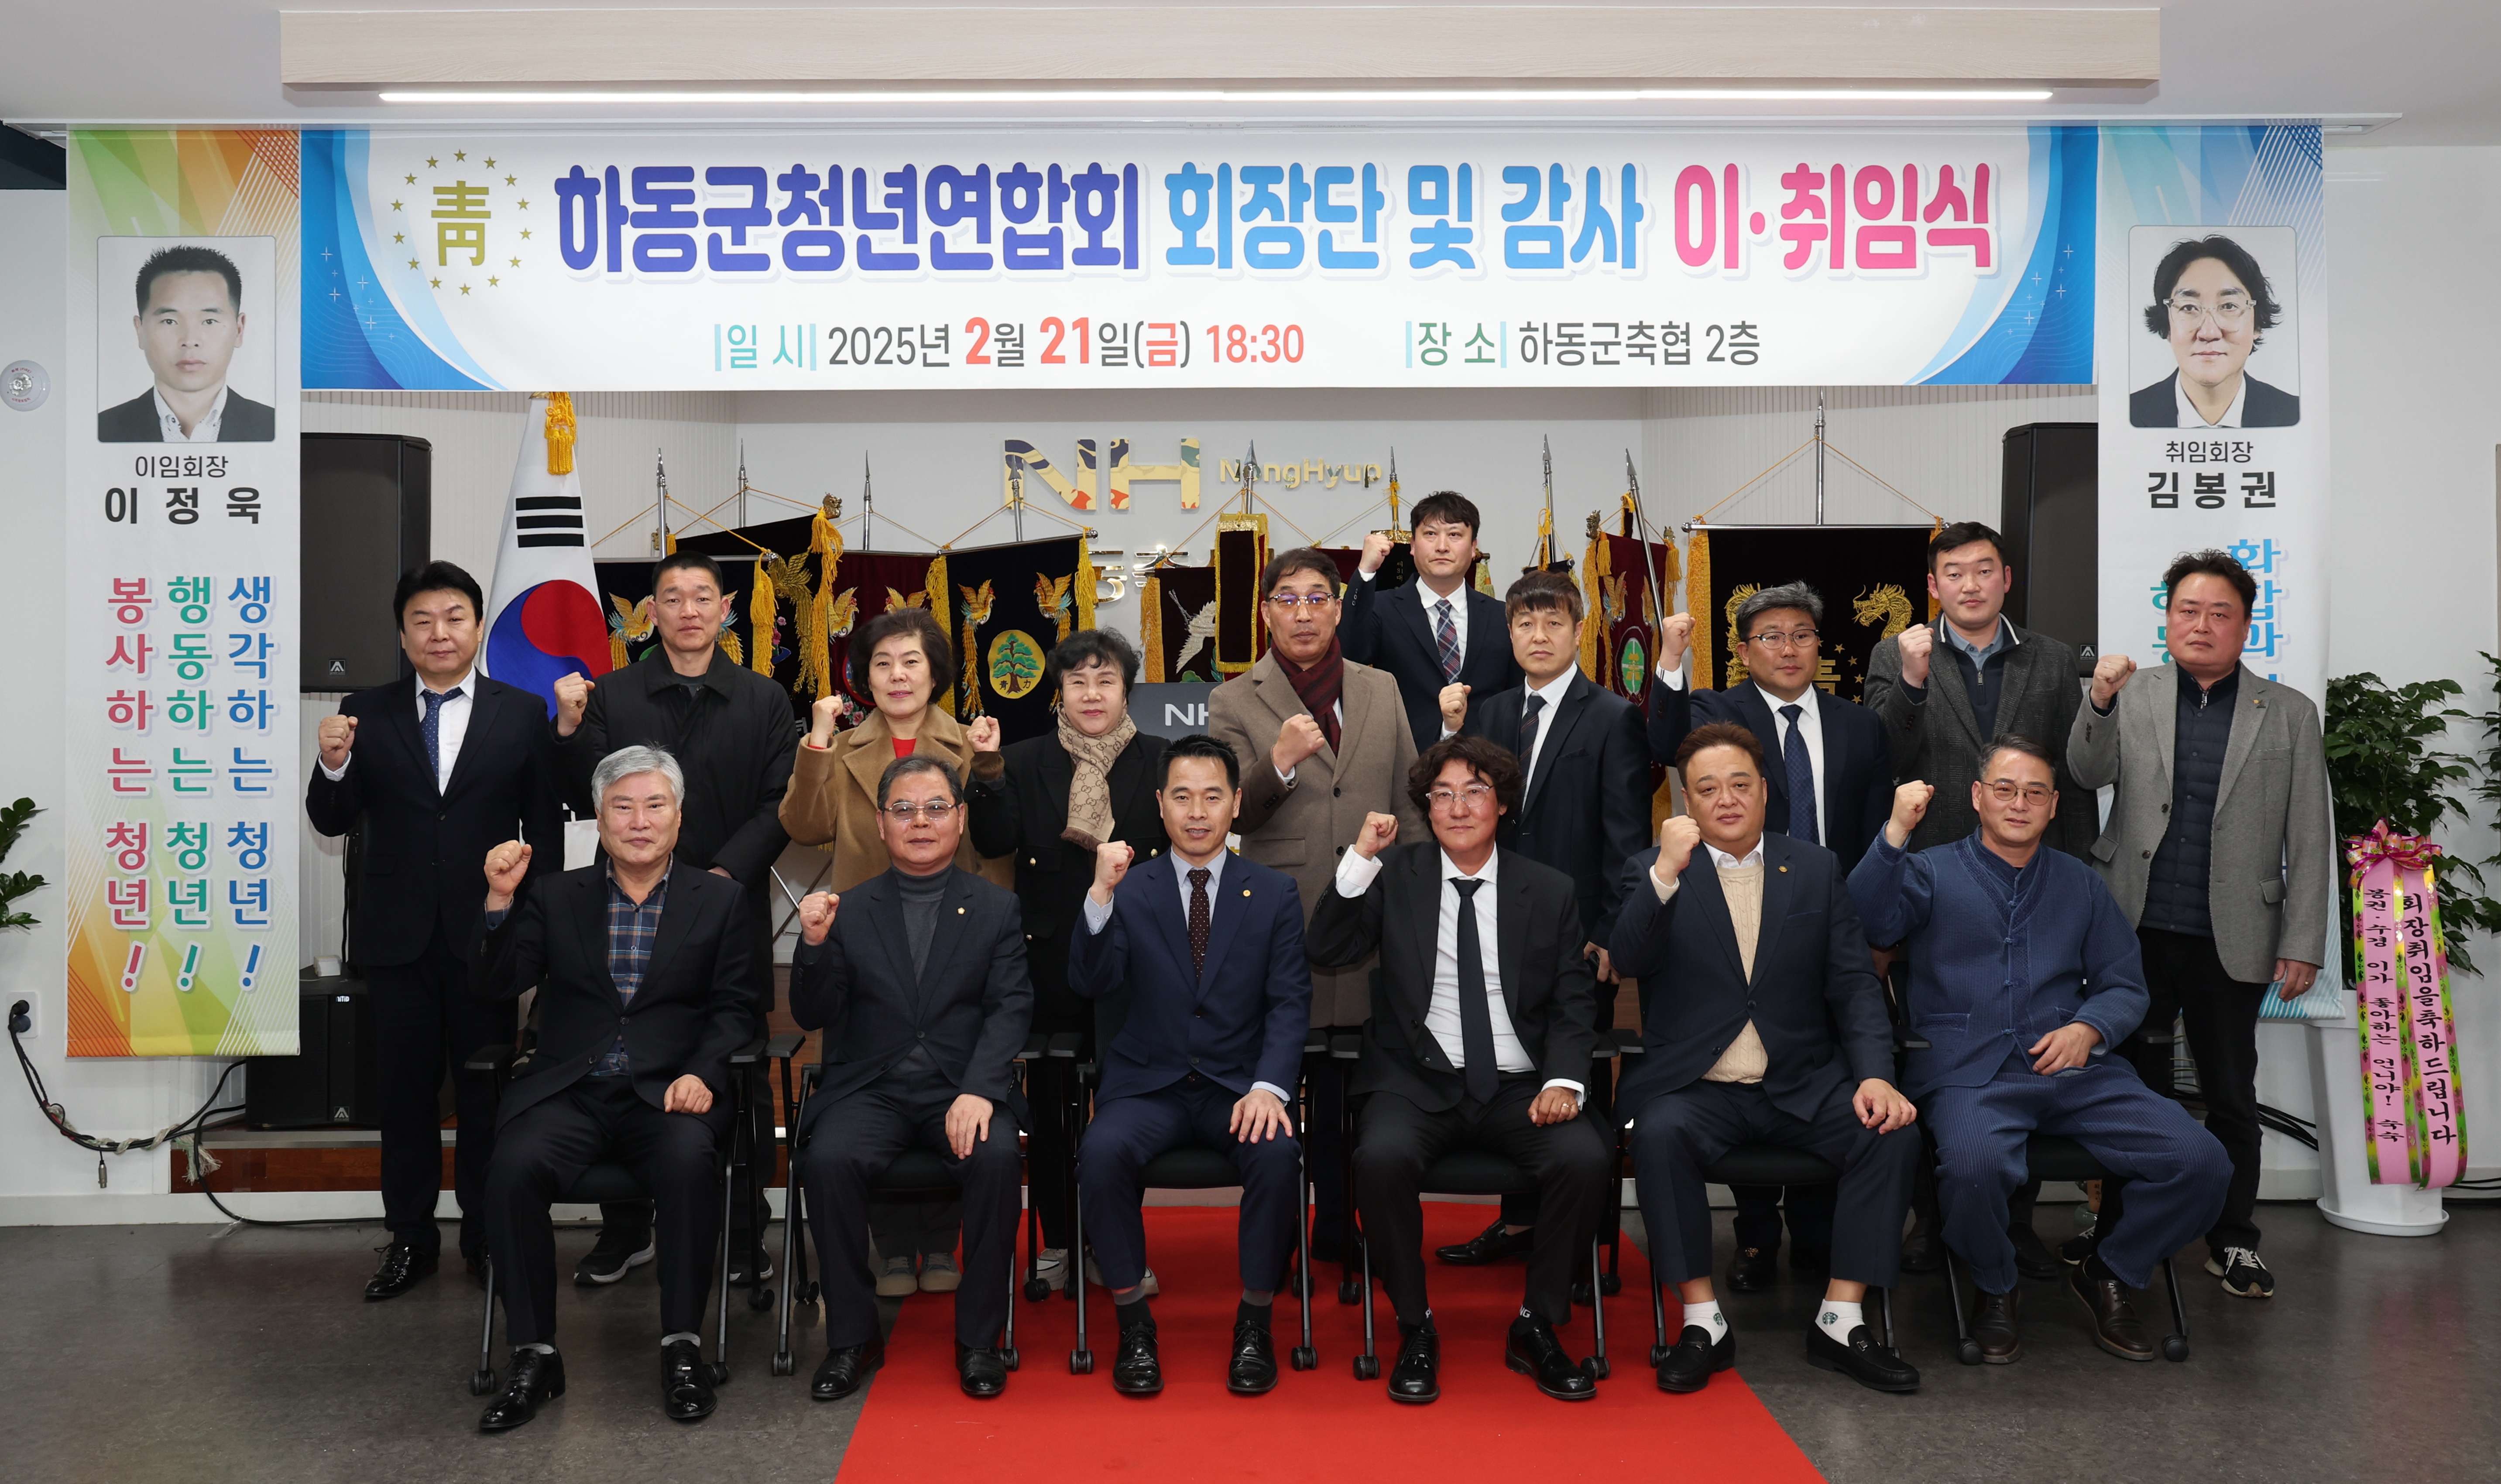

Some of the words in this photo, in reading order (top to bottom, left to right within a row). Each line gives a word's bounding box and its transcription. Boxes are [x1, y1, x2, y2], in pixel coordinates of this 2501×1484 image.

[555, 163, 1138, 272] 하동군청년연합회
[1165, 162, 1385, 269] 회장단
[1408, 163, 1475, 269] 및
[1501, 163, 1644, 269] 감사
[828, 324, 950, 367] 2025년
[965, 316, 1025, 367] 2월
[1040, 316, 1190, 369] 21일(금)
[1206, 323, 1304, 364] 18:30
[1519, 321, 1690, 366] 하동군축협
[1705, 321, 1760, 366] 2층
[135, 455, 229, 479] 이임회장
[1005, 439, 1200, 510] NH
[1220, 458, 1382, 488] NongHyup
[2165, 440, 2254, 463] 취임회장
[106, 577, 153, 792] 봉사하는
[167, 576, 213, 792] 행동하는
[227, 576, 275, 792] 생각하는
[2367, 960, 2394, 984] 이가
[2368, 997, 2398, 1045] 좋아하는
[2372, 1058, 2402, 1106] 언니야!
